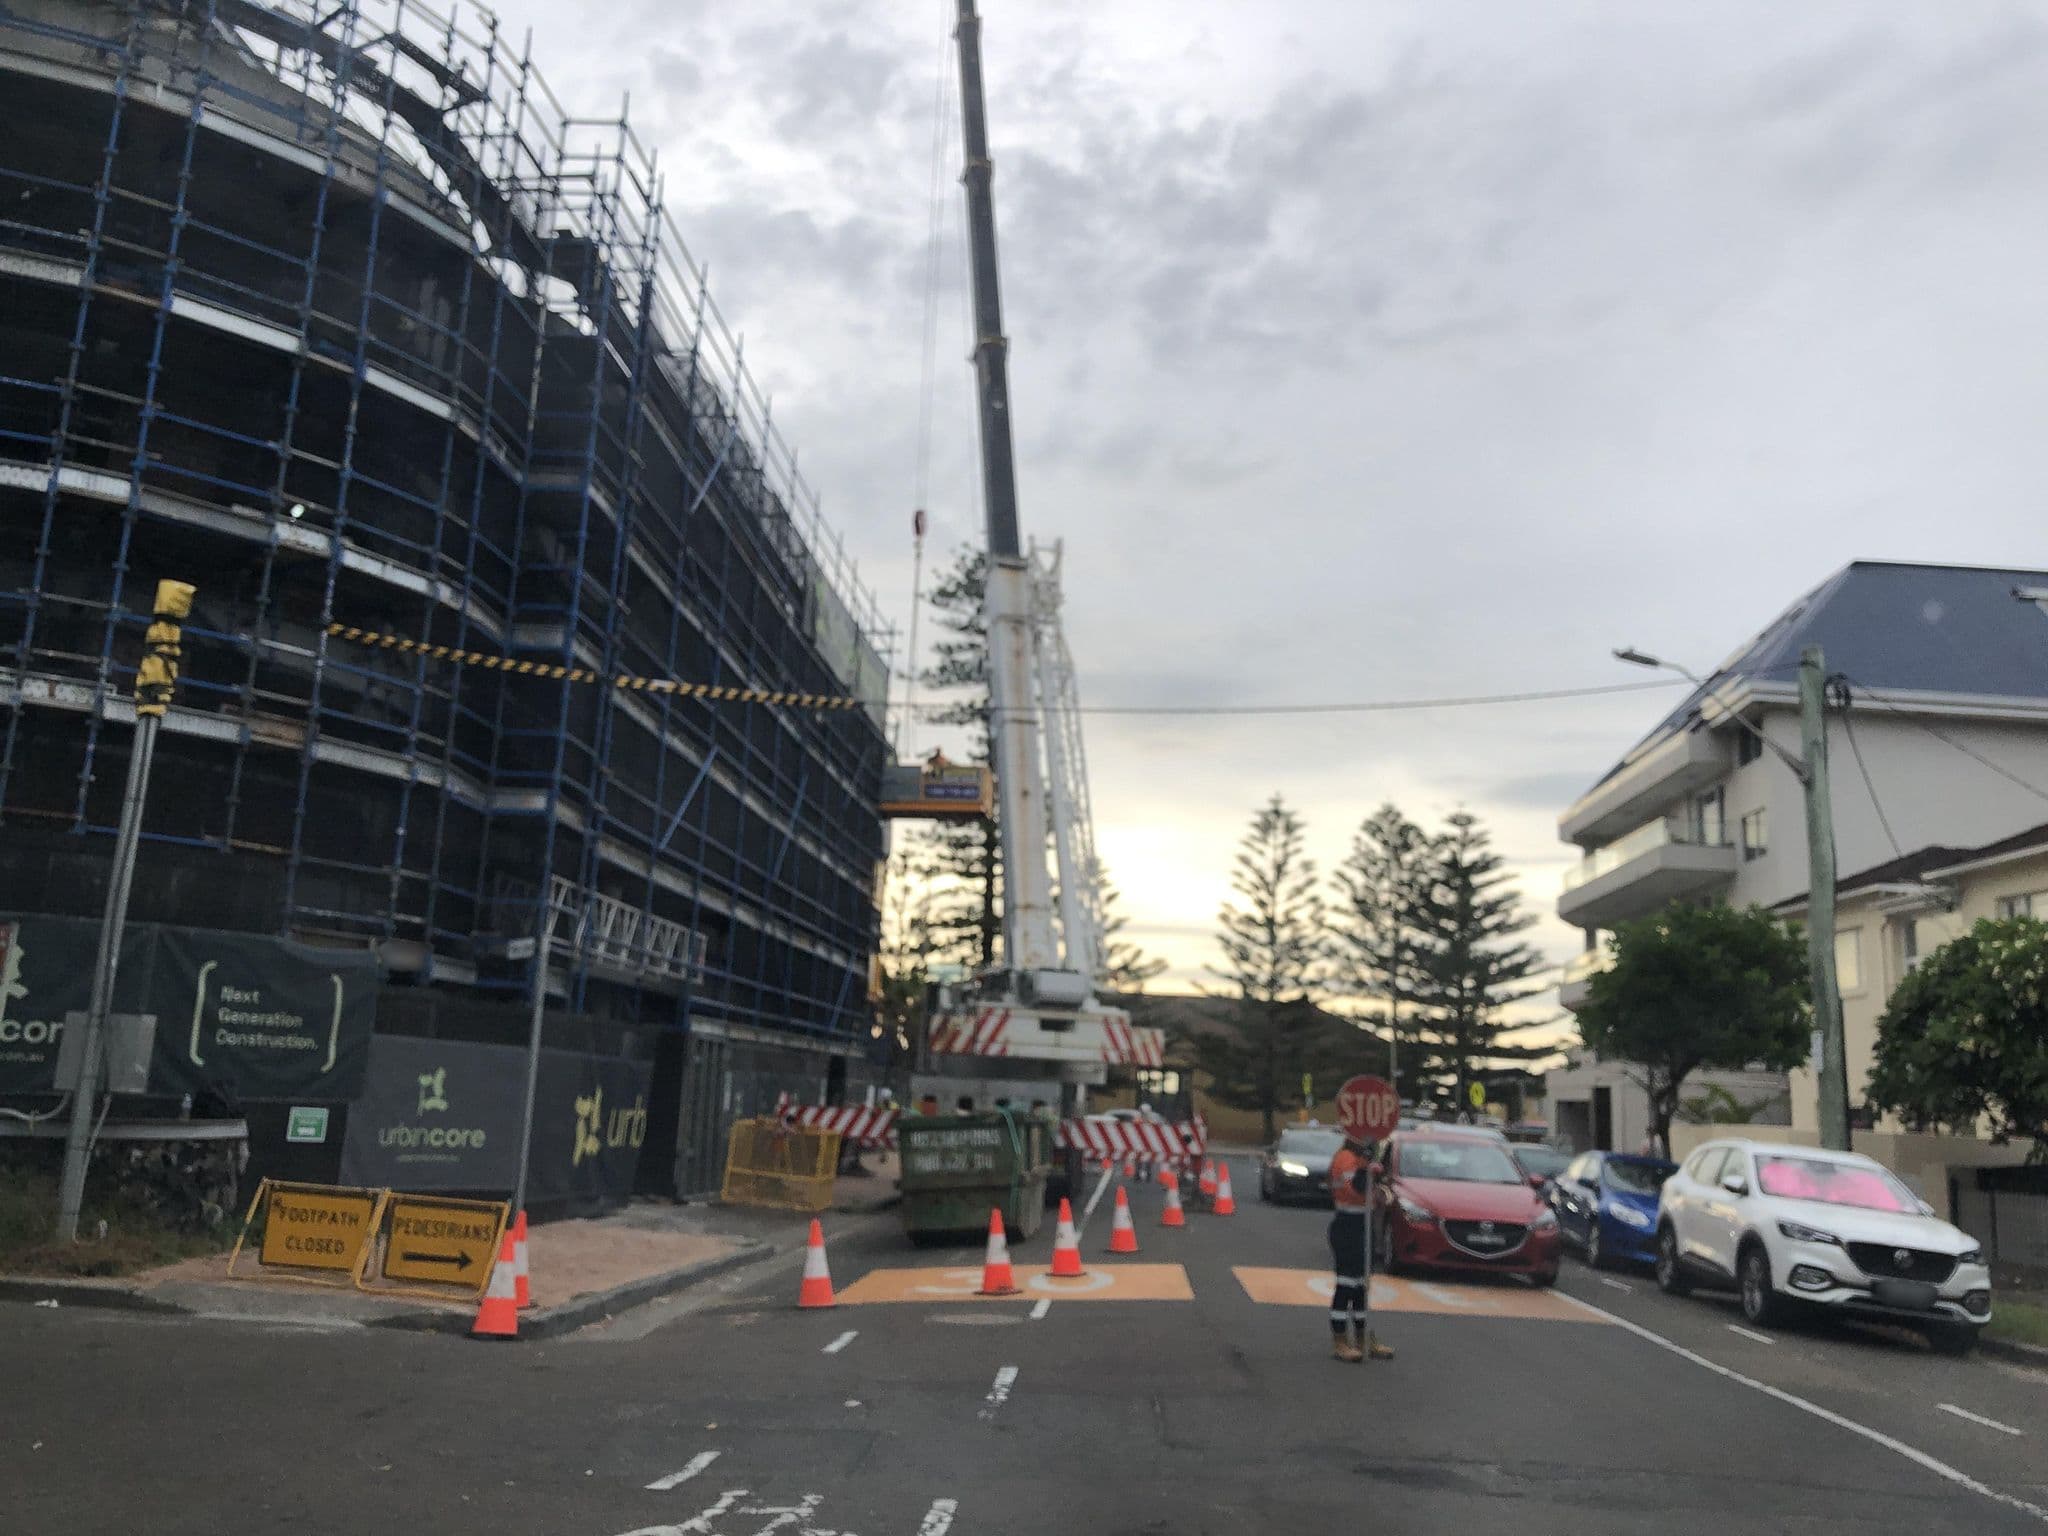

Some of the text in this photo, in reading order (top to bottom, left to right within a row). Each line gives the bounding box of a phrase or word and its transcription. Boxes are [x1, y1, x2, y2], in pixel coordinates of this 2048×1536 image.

[221, 984, 261, 1005] Next
[218, 1006, 304, 1029] Generation
[1340, 1092, 1396, 1127] STOP
[378, 1120, 487, 1149] urbncore
[279, 1205, 360, 1227] FOOTPATH
[395, 1217, 494, 1242] PEDESTRIANS
[285, 1235, 346, 1255] CLOSED
